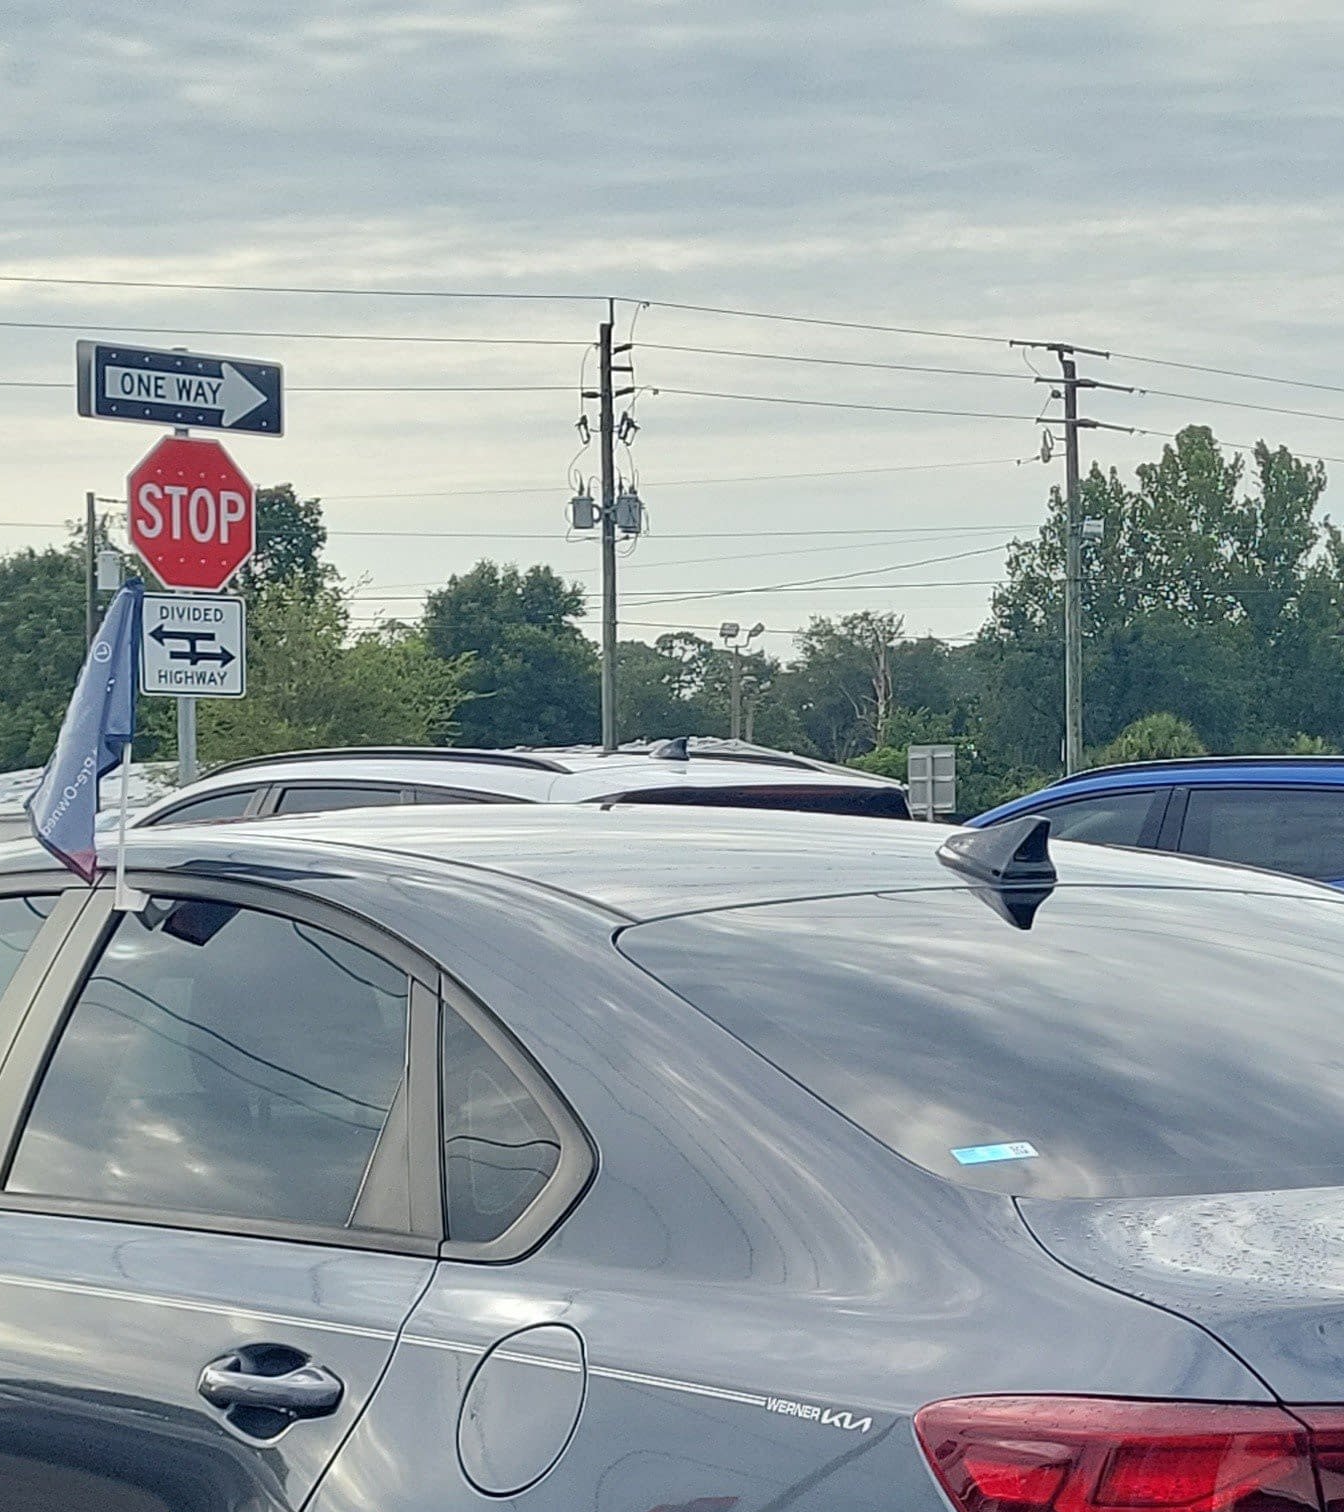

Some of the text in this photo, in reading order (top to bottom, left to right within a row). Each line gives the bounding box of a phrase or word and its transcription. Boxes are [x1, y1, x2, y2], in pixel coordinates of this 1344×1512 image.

[120, 372, 222, 404] ONE WAY
[137, 482, 247, 544] STOP
[159, 605, 224, 623] DIVIDED
[158, 669, 228, 687] HIGHWAY
[766, 1397, 873, 1434] WERNER KIA
